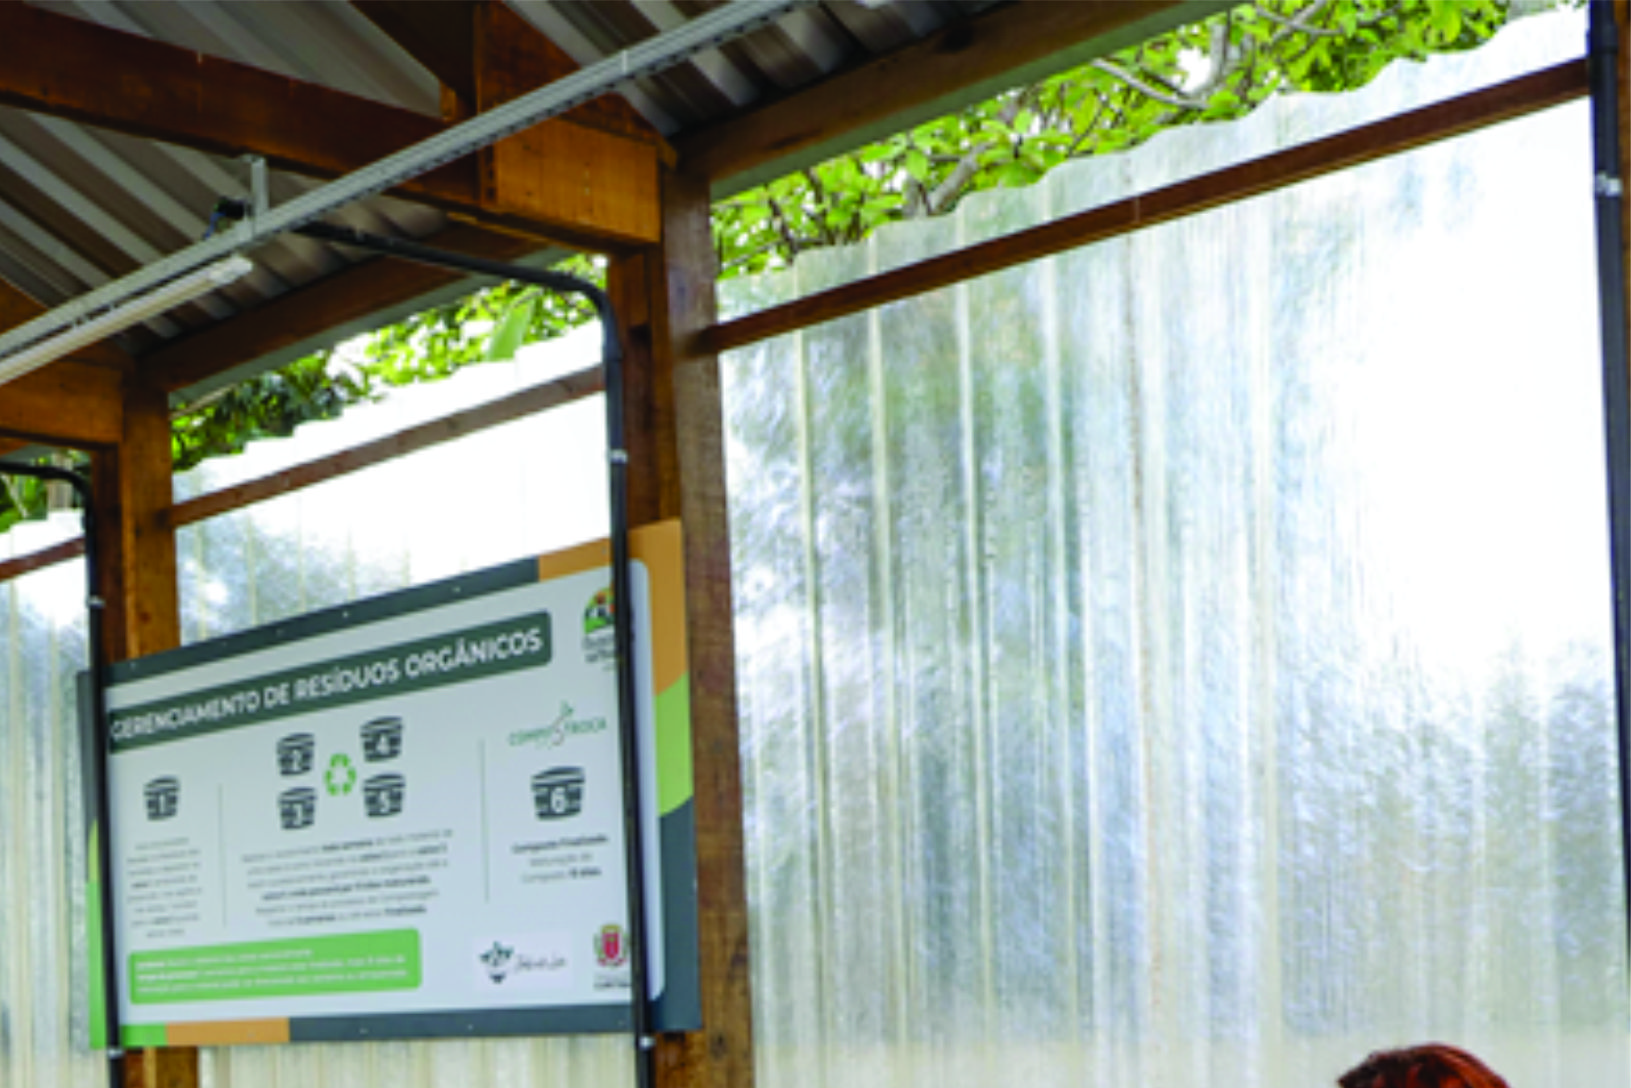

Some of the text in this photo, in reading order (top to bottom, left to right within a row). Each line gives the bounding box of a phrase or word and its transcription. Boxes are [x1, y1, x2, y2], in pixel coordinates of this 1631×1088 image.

[110, 690, 260, 740] GERENCIAMENTO
[263, 682, 290, 709] DE
[294, 656, 400, 699] RESÍDUOS
[405, 627, 542, 680] ORGÂNICOS
[376, 732, 390, 755] 4
[550, 786, 567, 815] 6
